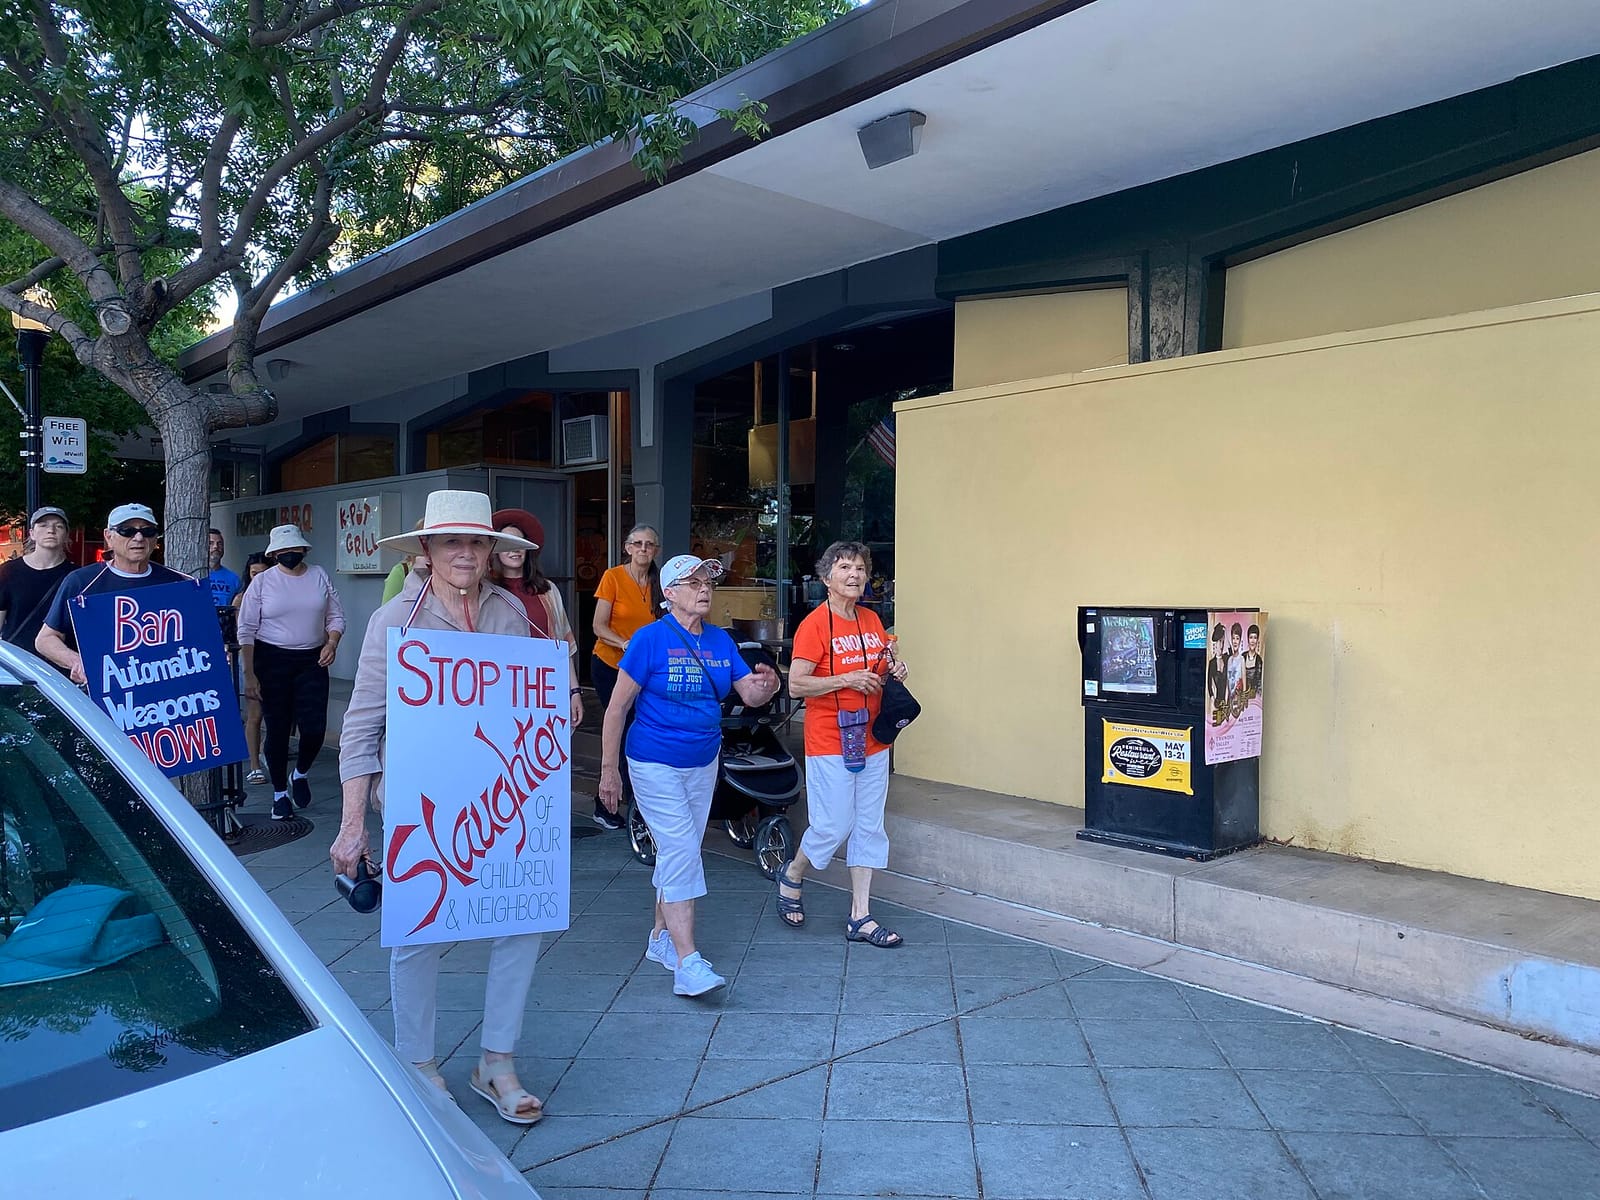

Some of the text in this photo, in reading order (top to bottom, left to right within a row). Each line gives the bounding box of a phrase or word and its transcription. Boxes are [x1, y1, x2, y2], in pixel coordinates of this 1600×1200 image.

[50, 421, 79, 431] FREE
[52, 436, 79, 446] WiFi
[280, 503, 313, 531] BBQ
[346, 530, 379, 557] GRILL
[114, 596, 184, 654] Ban
[1184, 633, 1206, 641] LOCAL
[1185, 626, 1205, 636] SHOP
[102, 646, 212, 693] Automatic
[397, 640, 557, 709] STOP THE
[668, 666, 683, 674] NOT
[668, 674, 703, 683] NOT JUST
[667, 683, 683, 691] NOT
[102, 689, 221, 732] Weapons
[128, 716, 222, 768] NOW!
[1121, 744, 1154, 753] PENINSULA
[1164, 742, 1185, 751] MAY
[1164, 750, 1185, 760] 13-21
[386, 712, 569, 938] Slaughter
[528, 826, 561, 853] OUR
[480, 860, 554, 890] CHILDREN
[445, 892, 558, 931] & NEIGHBORS
